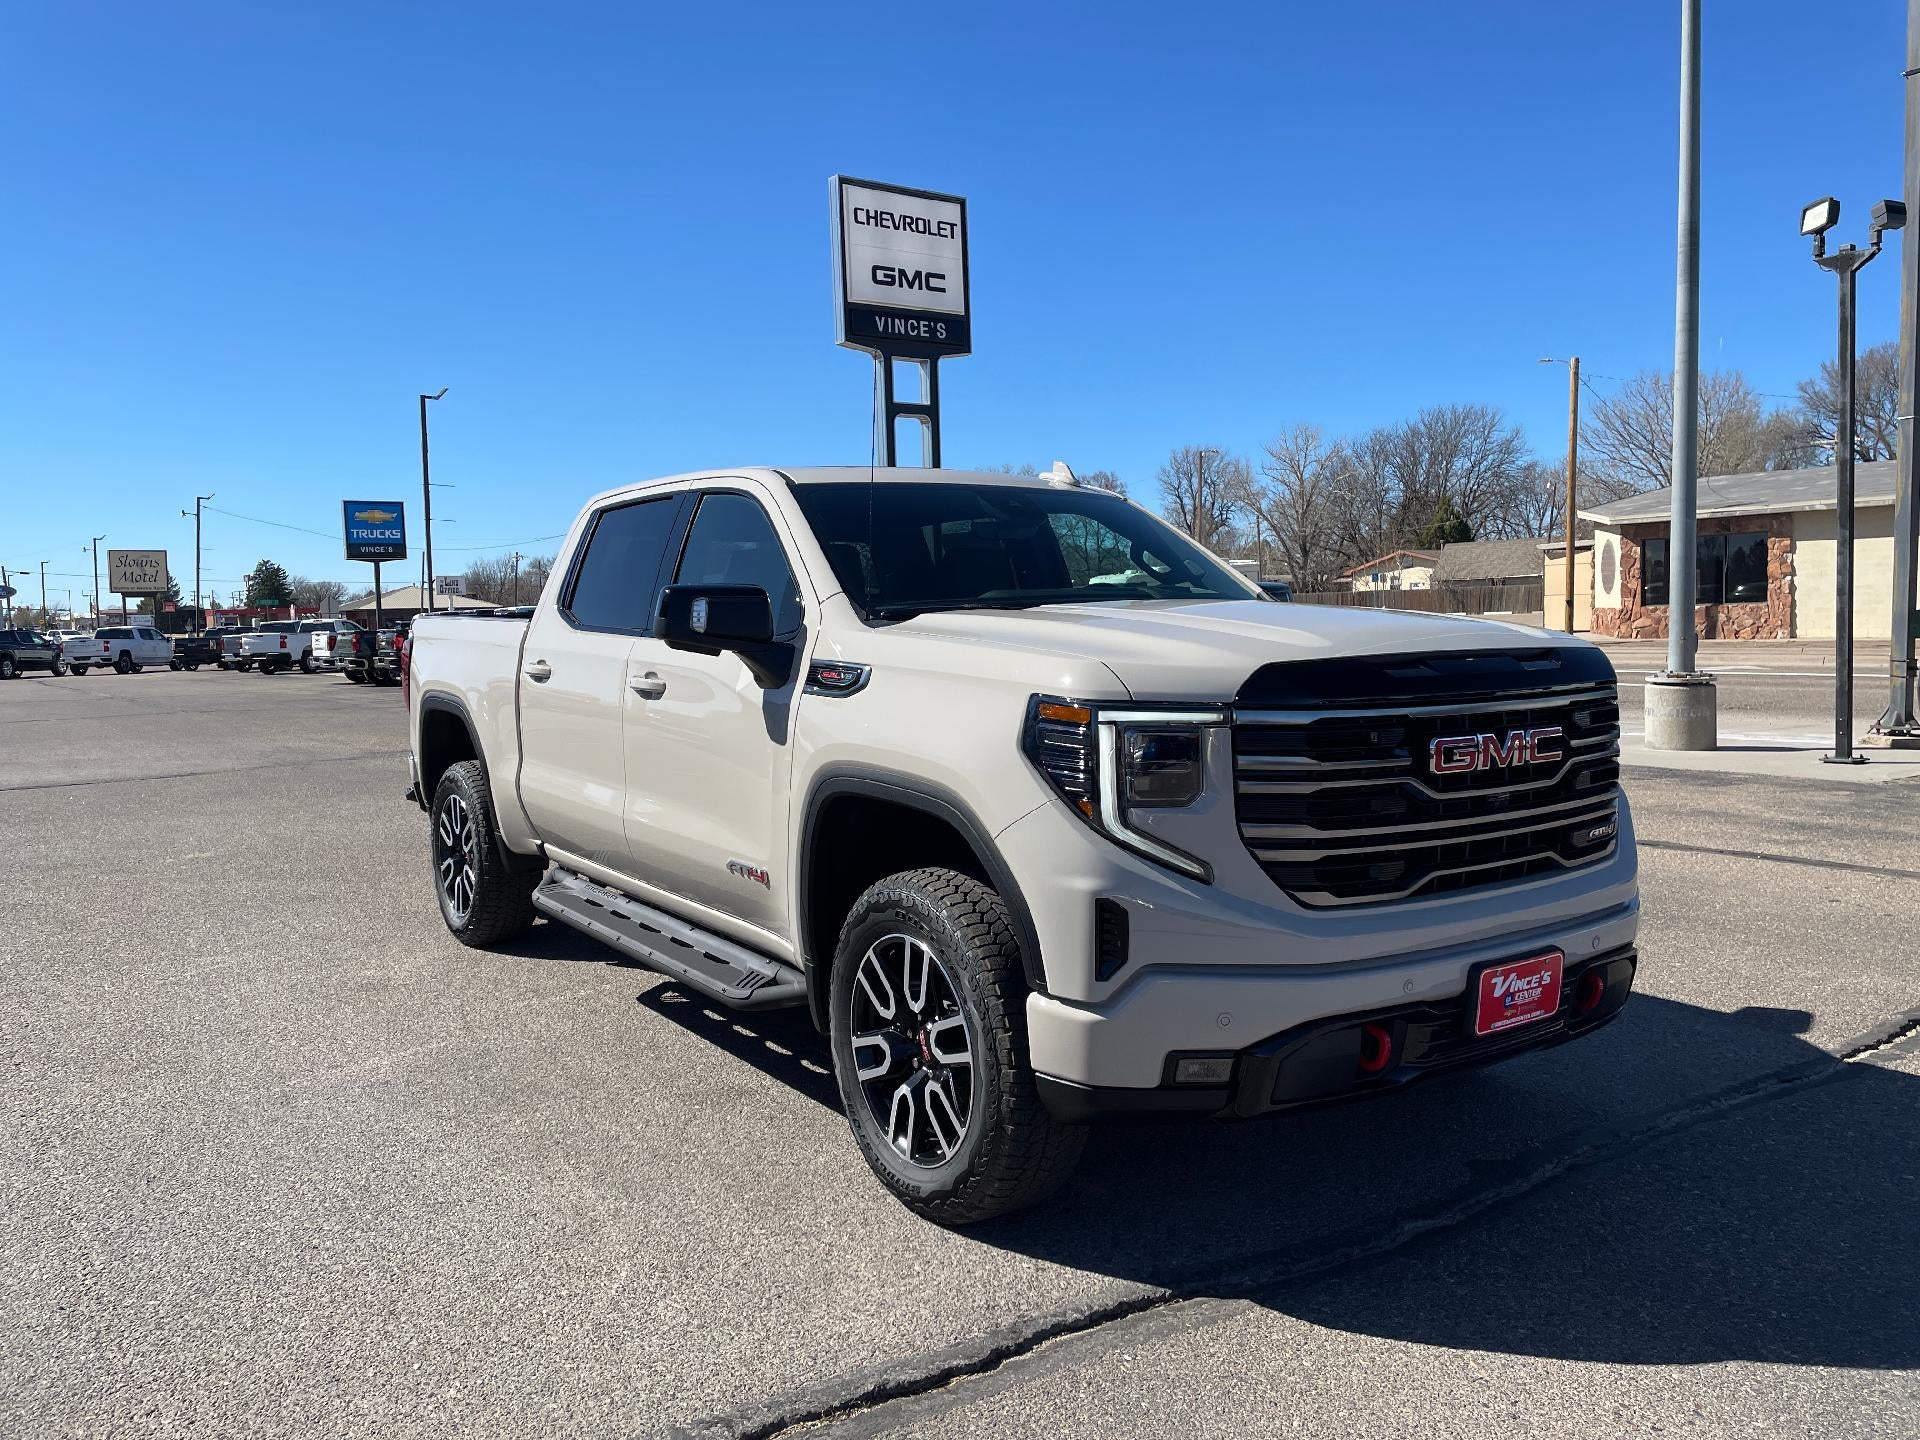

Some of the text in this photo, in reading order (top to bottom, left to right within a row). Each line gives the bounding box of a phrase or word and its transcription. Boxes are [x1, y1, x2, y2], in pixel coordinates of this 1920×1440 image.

[853, 207, 957, 239] CHEVROLET
[871, 265, 946, 293] GMC
[875, 316, 947, 338] VINCE'S
[350, 529, 401, 539] TRUCKS
[118, 570, 159, 582] Motel
[1430, 727, 1562, 775] GMC
[1491, 970, 1552, 998] VINCE'S
[1515, 987, 1542, 1002] CENTER
